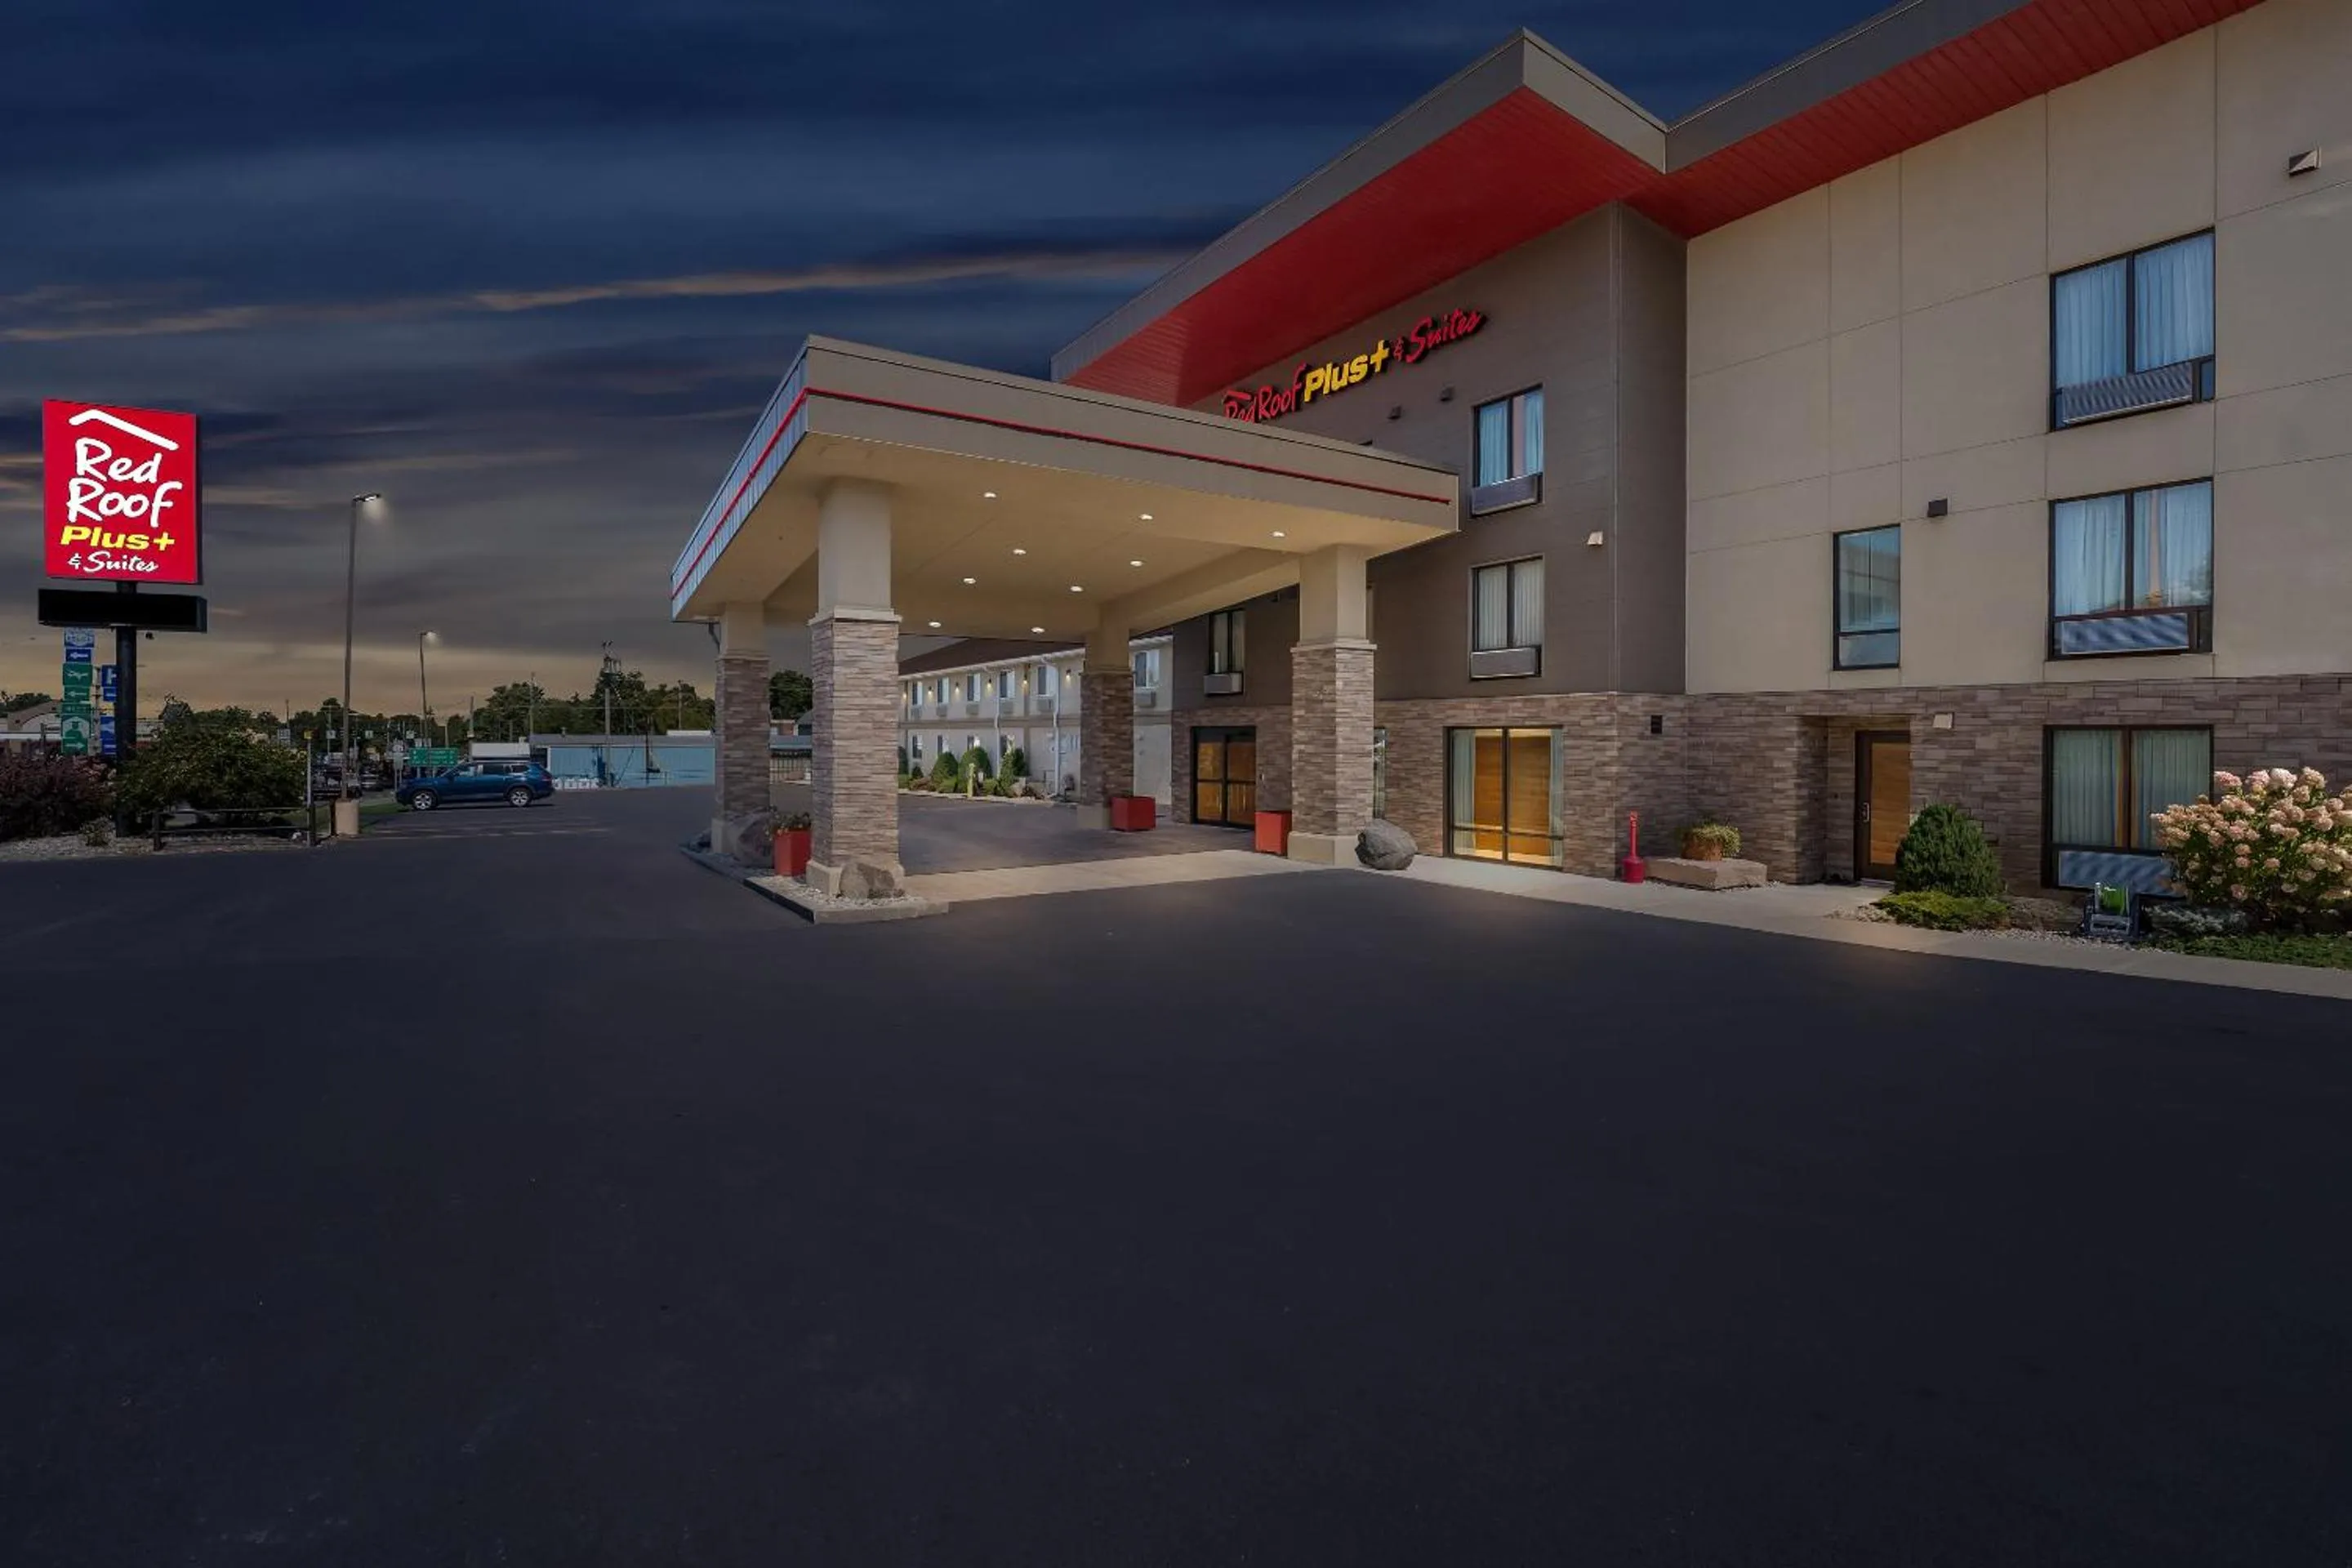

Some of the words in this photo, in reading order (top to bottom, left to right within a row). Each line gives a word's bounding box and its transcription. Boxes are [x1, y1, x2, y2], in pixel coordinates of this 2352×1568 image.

[1258, 359, 1307, 419] Roof
[1303, 340, 1389, 402] Plus+
[1405, 308, 1481, 363] Suites
[75, 437, 162, 483] Red
[66, 477, 183, 528] Roof
[60, 525, 175, 551] Plus+
[68, 553, 82, 569] &
[83, 550, 158, 572] Suites
